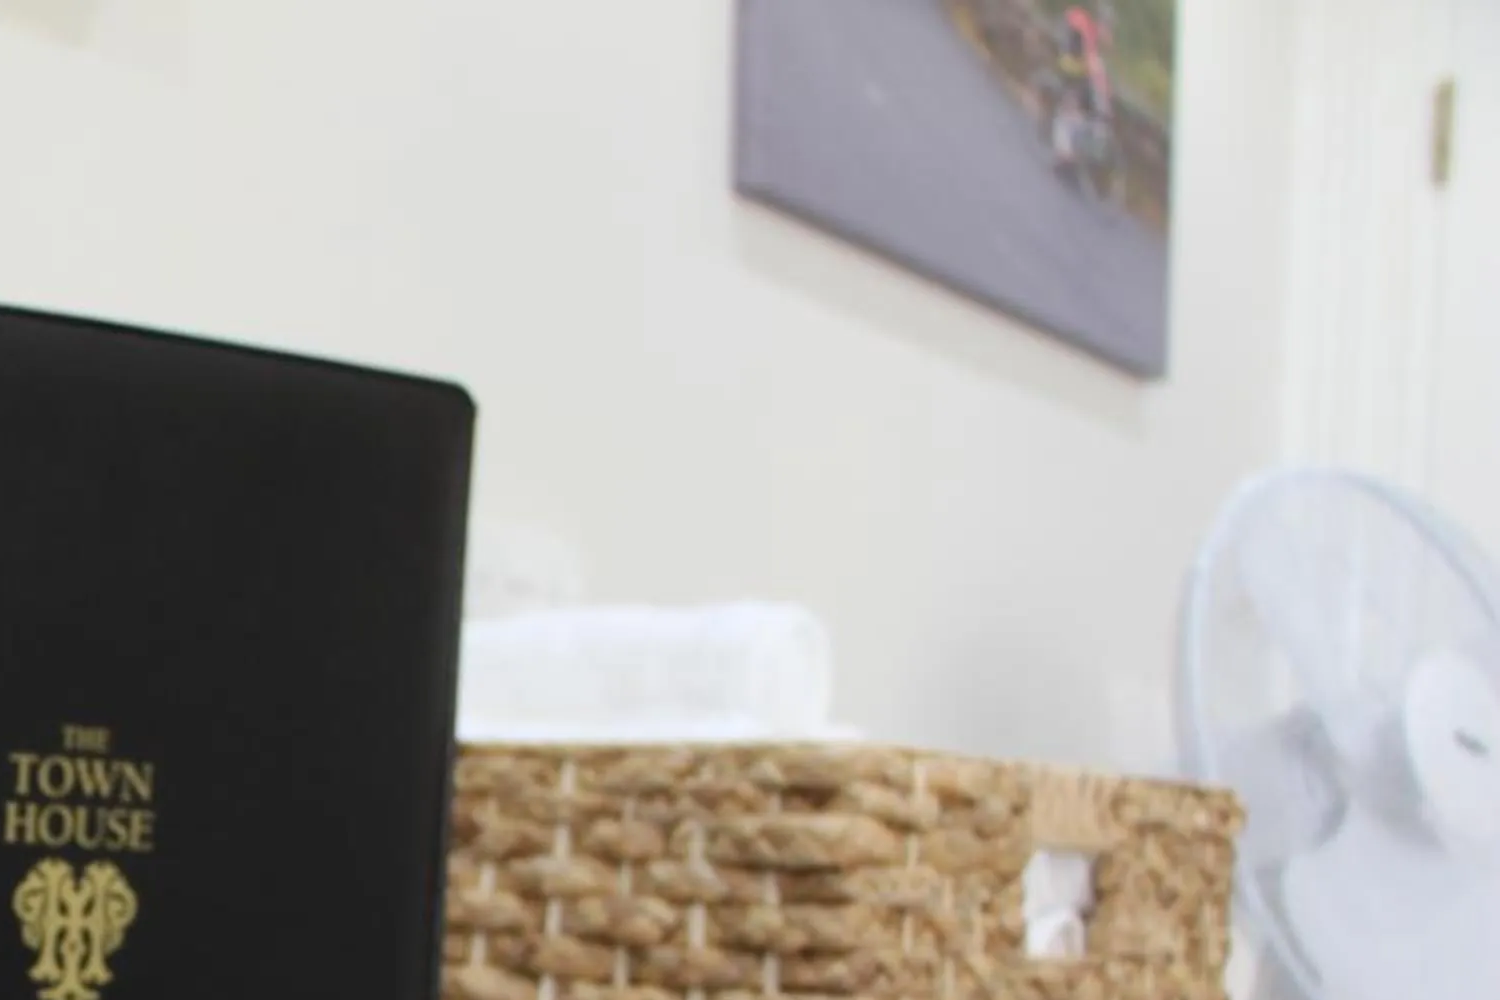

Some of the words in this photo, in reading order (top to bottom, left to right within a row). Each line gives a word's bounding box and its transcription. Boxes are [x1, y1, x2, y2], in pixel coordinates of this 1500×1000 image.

[63, 724, 110, 753] THE
[8, 752, 154, 802] TOWN
[3, 801, 155, 851] HOUSE
